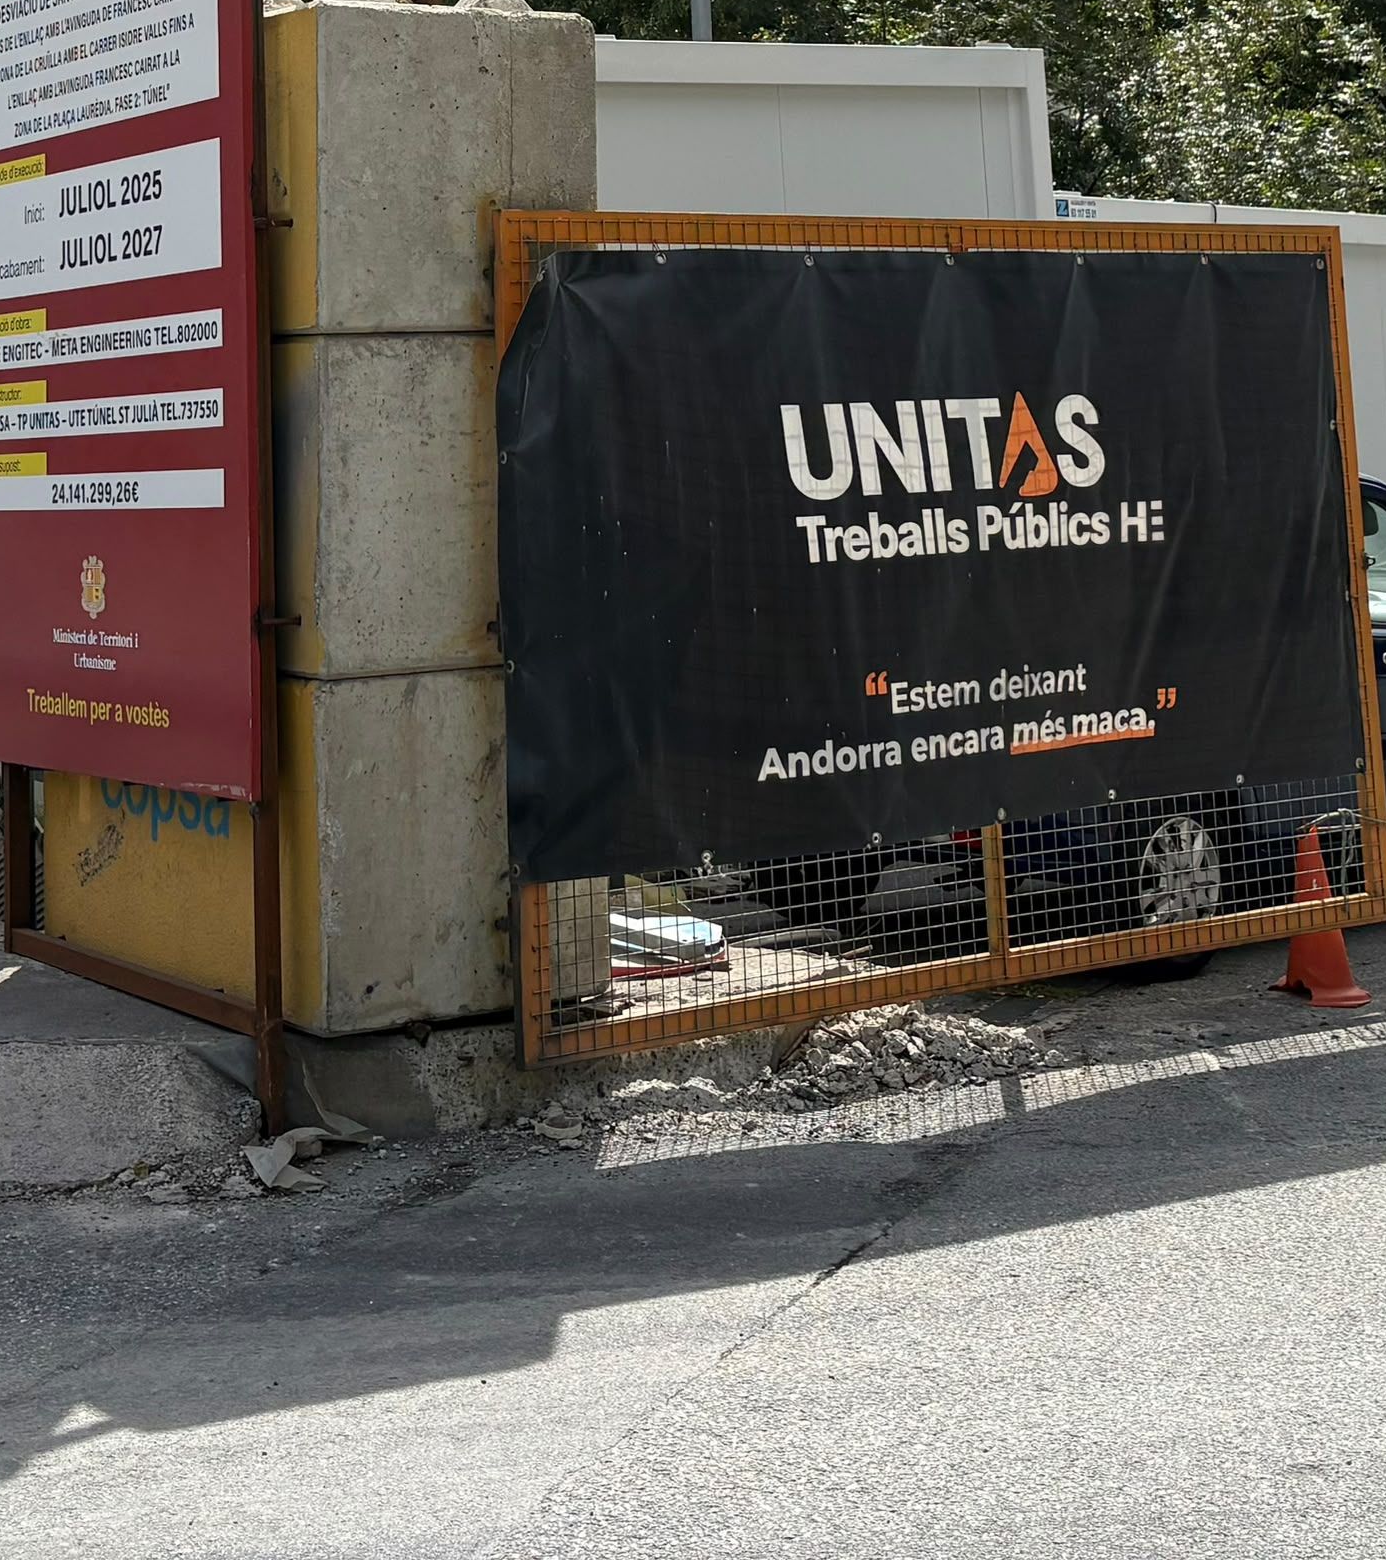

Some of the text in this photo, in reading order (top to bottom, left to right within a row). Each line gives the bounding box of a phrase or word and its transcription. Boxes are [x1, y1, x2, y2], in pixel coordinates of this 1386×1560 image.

[5, 36, 13, 52] DE
[45, 21, 61, 39] AMB
[61, 9, 102, 35] L'AVINGUDA
[102, 5, 112, 22] DE
[15, 62, 24, 78] DE
[25, 59, 33, 75] LA
[63, 46, 78, 64] AMB
[79, 44, 88, 59] EL
[89, 34, 117, 56] CARRER
[118, 27, 142, 48] ISIDRE
[144, 20, 168, 41] VALLS
[169, 14, 187, 34] FINS
[188, 12, 194, 28] A
[38, 84, 53, 101] AMB
[54, 72, 94, 97] L'AVINGUDA
[95, 62, 133, 85] FRANCESC
[134, 53, 161, 76] CAIRAT
[162, 52, 168, 68] A
[170, 48, 180, 66] LA
[14, 120, 32, 138] ZONA
[33, 116, 42, 132] DE
[43, 114, 52, 130] LA
[53, 108, 76, 129] PLAÇA
[115, 93, 133, 113] FASE
[134, 91, 141, 108] 2:
[24, 170, 162, 224] Inici: JULIOL 2025
[60, 233, 117, 270] JULIOL
[122, 225, 163, 260] 2027
[3, 342, 42, 362] ENGITEC
[52, 337, 78, 357] META
[81, 331, 152, 354] ENGINEERING
[154, 321, 218, 345] TEL.802000
[17, 413, 28, 431] TP
[29, 411, 60, 430] UNITAS
[68, 409, 86, 427] UTE
[87, 404, 117, 425] TÚNEL
[119, 406, 130, 424] ST
[131, 400, 159, 423] JULIÀ
[160, 399, 218, 421] TEL.737550
[780, 391, 1106, 501] UNITAS
[52, 481, 139, 506] 24.141.299,26€
[795, 507, 969, 564] Treballs
[977, 502, 1110, 551] Públics
[52, 628, 139, 648] Ministeri de Territori i
[73, 653, 116, 671] Urbanisme
[989, 664, 1086, 703] deixant
[26, 688, 170, 728] Treballem per a vostès
[758, 739, 902, 781] Andorra
[911, 724, 1005, 762] encara
[1013, 713, 1066, 747] més
